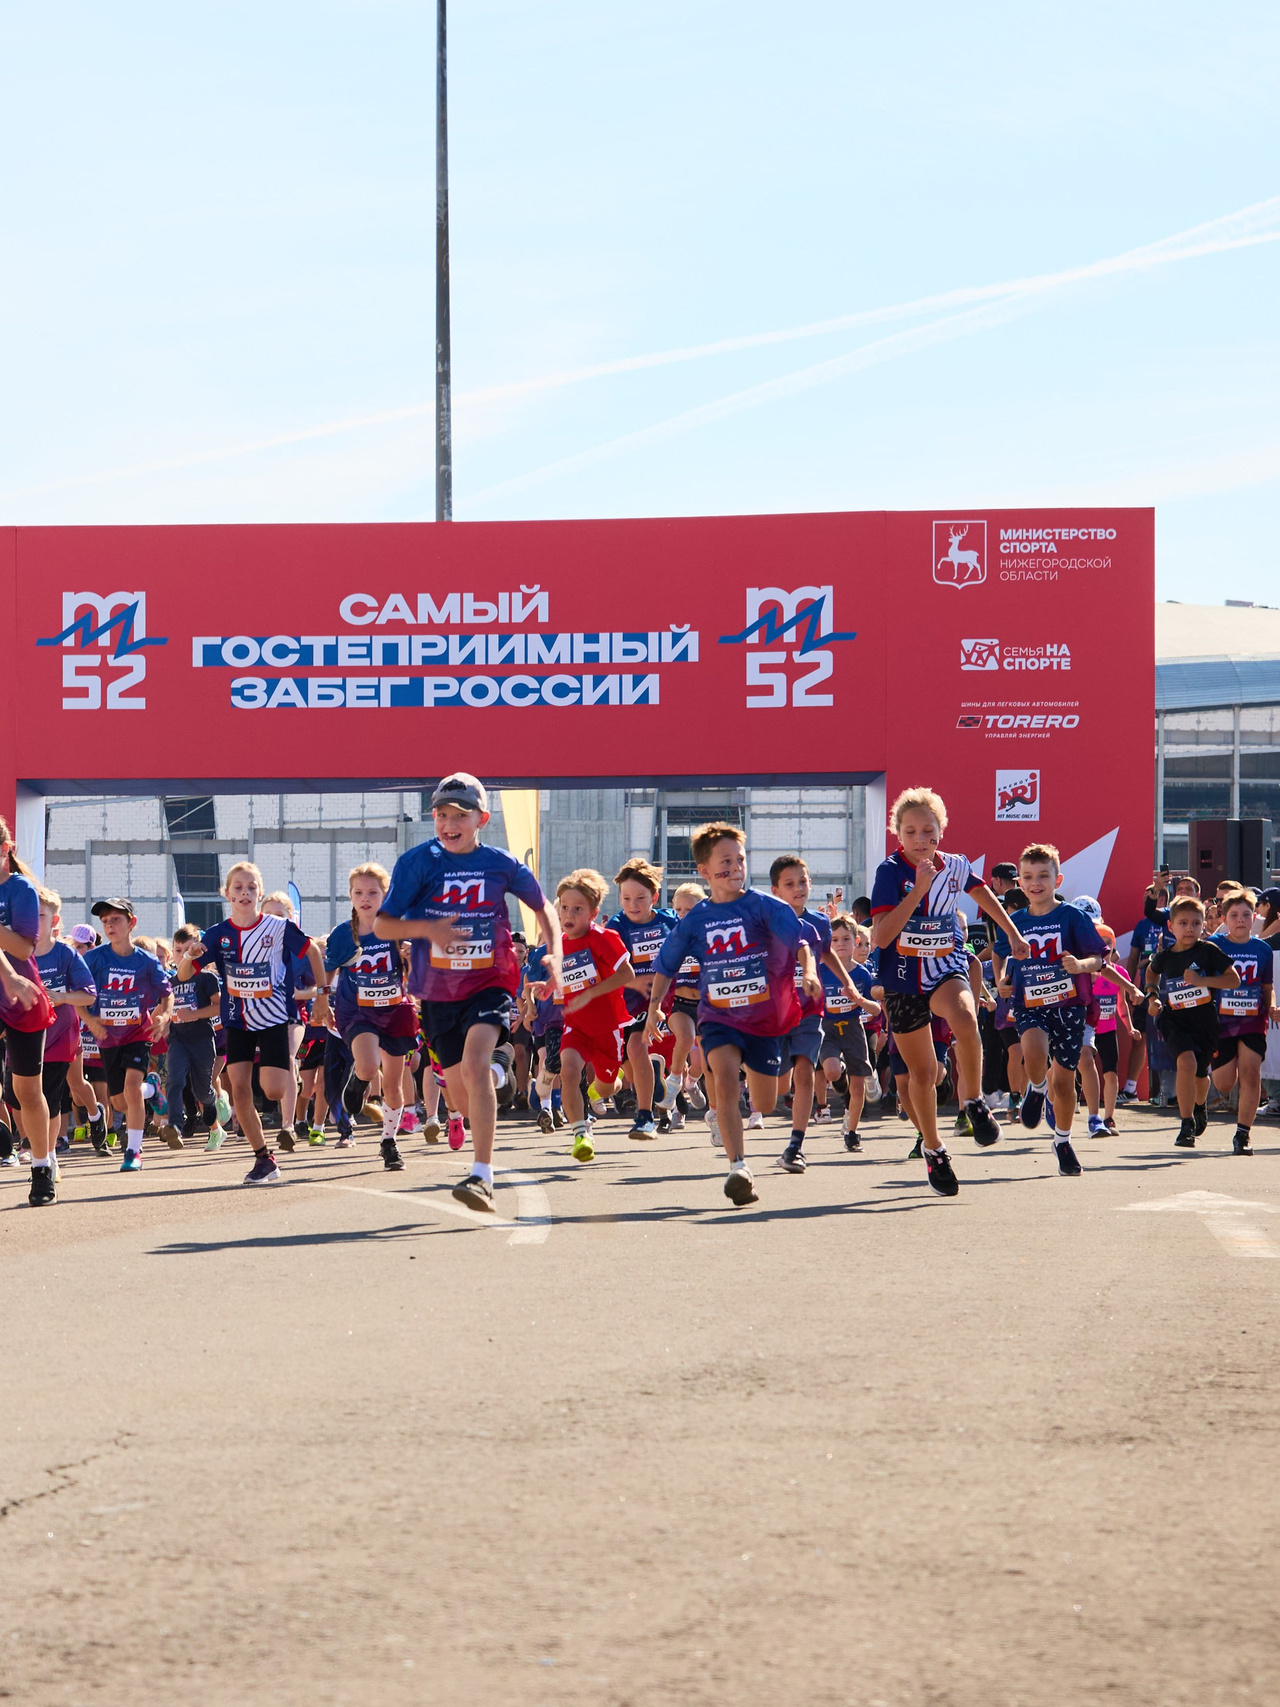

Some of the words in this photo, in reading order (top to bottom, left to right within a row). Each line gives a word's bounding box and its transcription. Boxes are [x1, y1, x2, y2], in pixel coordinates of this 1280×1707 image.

[999, 528, 1117, 540] МИНИСТЕРСТВО
[999, 542, 1058, 554] СПОРТА
[1000, 556, 1112, 570] НИЖЕГОРОДСКОЙ
[1000, 570, 1059, 581] ОБЛАСТИ
[339, 584, 549, 626] САМЫЙ
[192, 624, 700, 668] ГОСТЕПРИИМНЫЙ
[1003, 646, 1044, 658] СЕМЬЯ
[1046, 644, 1071, 656] НА
[1003, 658, 1072, 670] СПОРТЕ
[62, 654, 147, 710] 52
[745, 650, 834, 709] 52
[230, 677, 410, 709] ЗАБЕГ
[423, 673, 660, 708] РОССИИ
[985, 714, 1080, 729] TORERO
[998, 778, 1029, 792] ENERGY
[998, 772, 1038, 811] NRJ
[906, 936, 948, 946] 10675
[445, 944, 482, 955] 0571
[563, 969, 588, 982] 11021
[716, 982, 758, 995] 10475
[1030, 982, 1068, 997] 10230
[1174, 990, 1202, 1000] 10198
